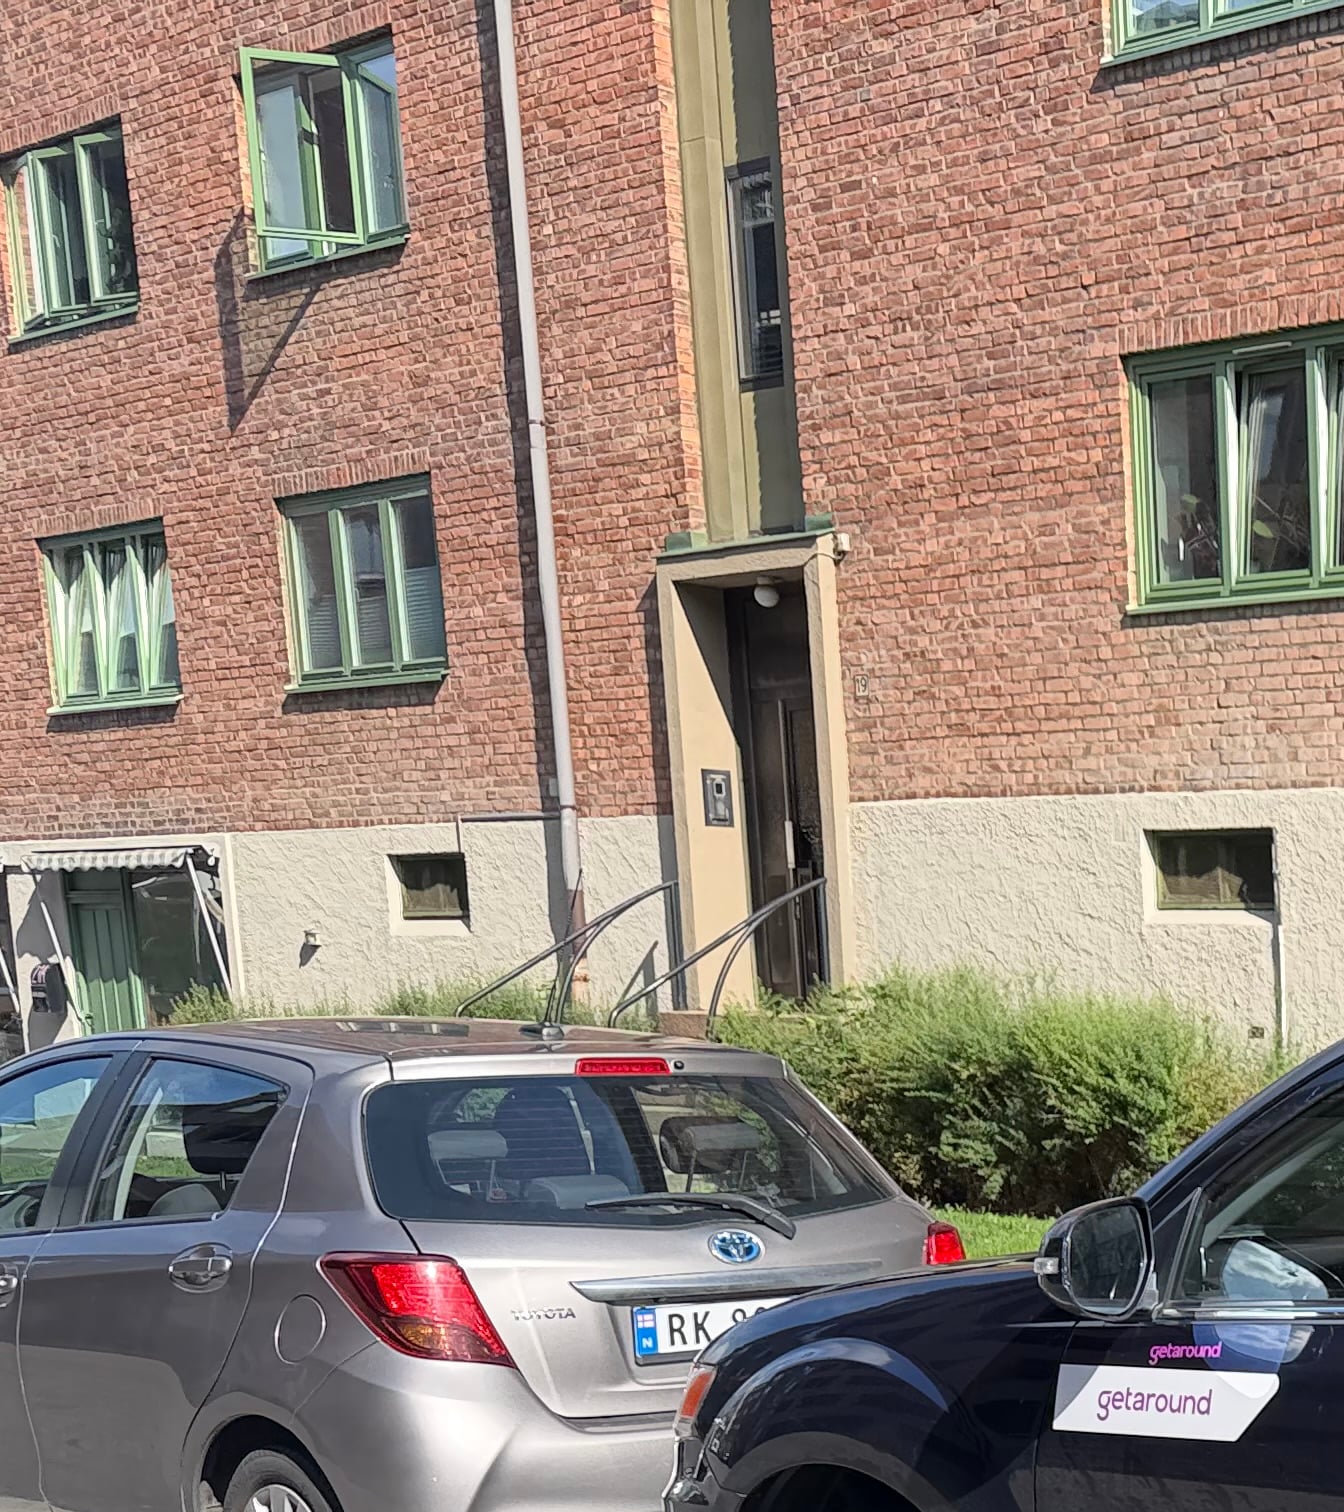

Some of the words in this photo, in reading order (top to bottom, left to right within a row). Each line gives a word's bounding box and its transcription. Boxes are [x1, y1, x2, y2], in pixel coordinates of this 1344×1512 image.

[856, 676, 867, 693] 19
[511, 1307, 577, 1320] TOYOTA
[1149, 1341, 1223, 1366] getaround
[1096, 1386, 1213, 1422] getaround
